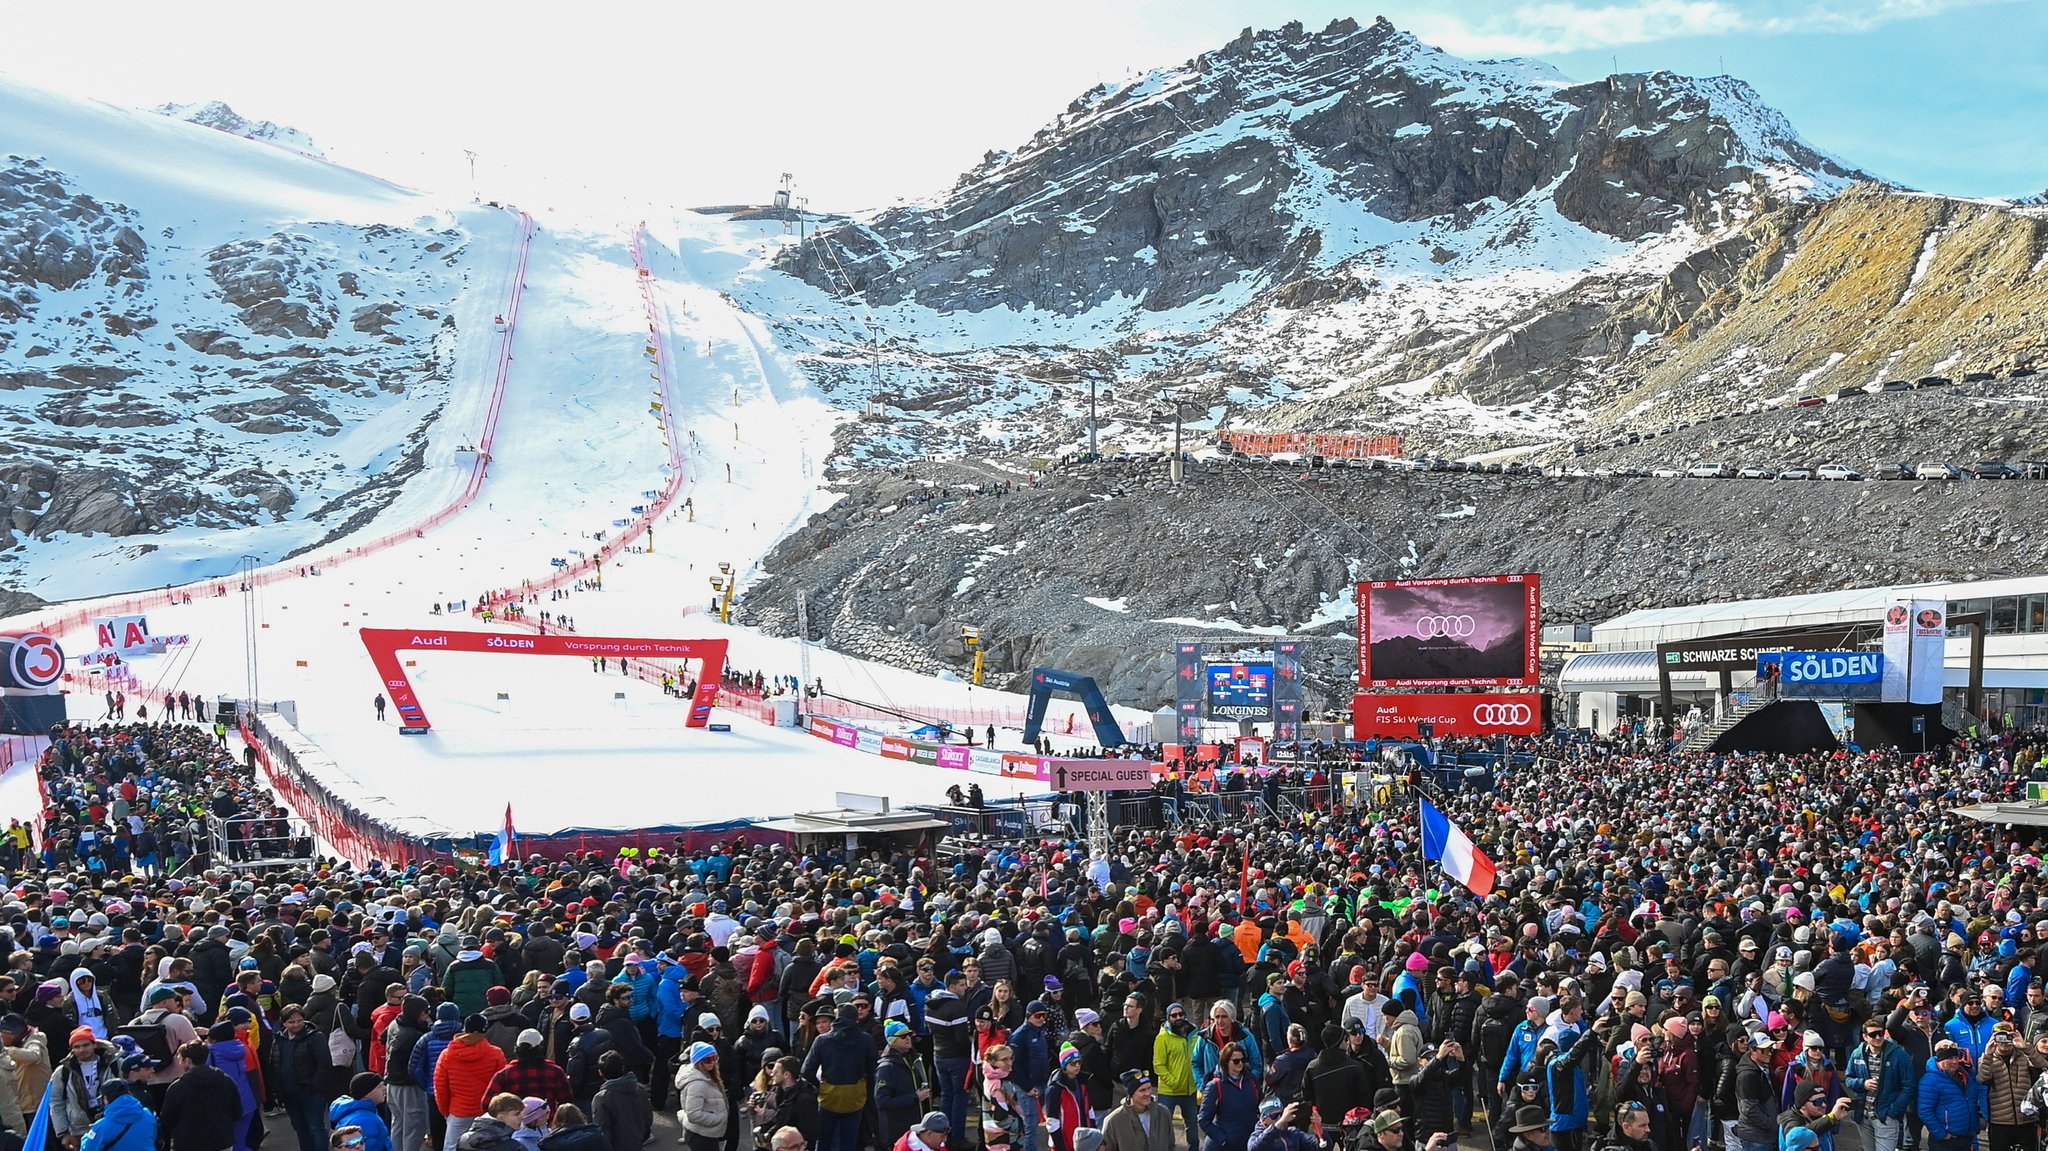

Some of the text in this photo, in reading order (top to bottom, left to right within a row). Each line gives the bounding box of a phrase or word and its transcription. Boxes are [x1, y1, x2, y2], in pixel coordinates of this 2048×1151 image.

[124, 618, 148, 648] A1
[411, 636, 448, 645] Audi
[486, 637, 534, 648] SÖLDEN
[565, 641, 620, 651] Vorsprung
[1683, 649, 1738, 662] SCHWARZE
[1790, 654, 1878, 681] SÖLDEN
[1212, 706, 1268, 715] LONGINES
[1438, 716, 1456, 724] Cup
[1071, 770, 1148, 781] SPECIAL GUEST
